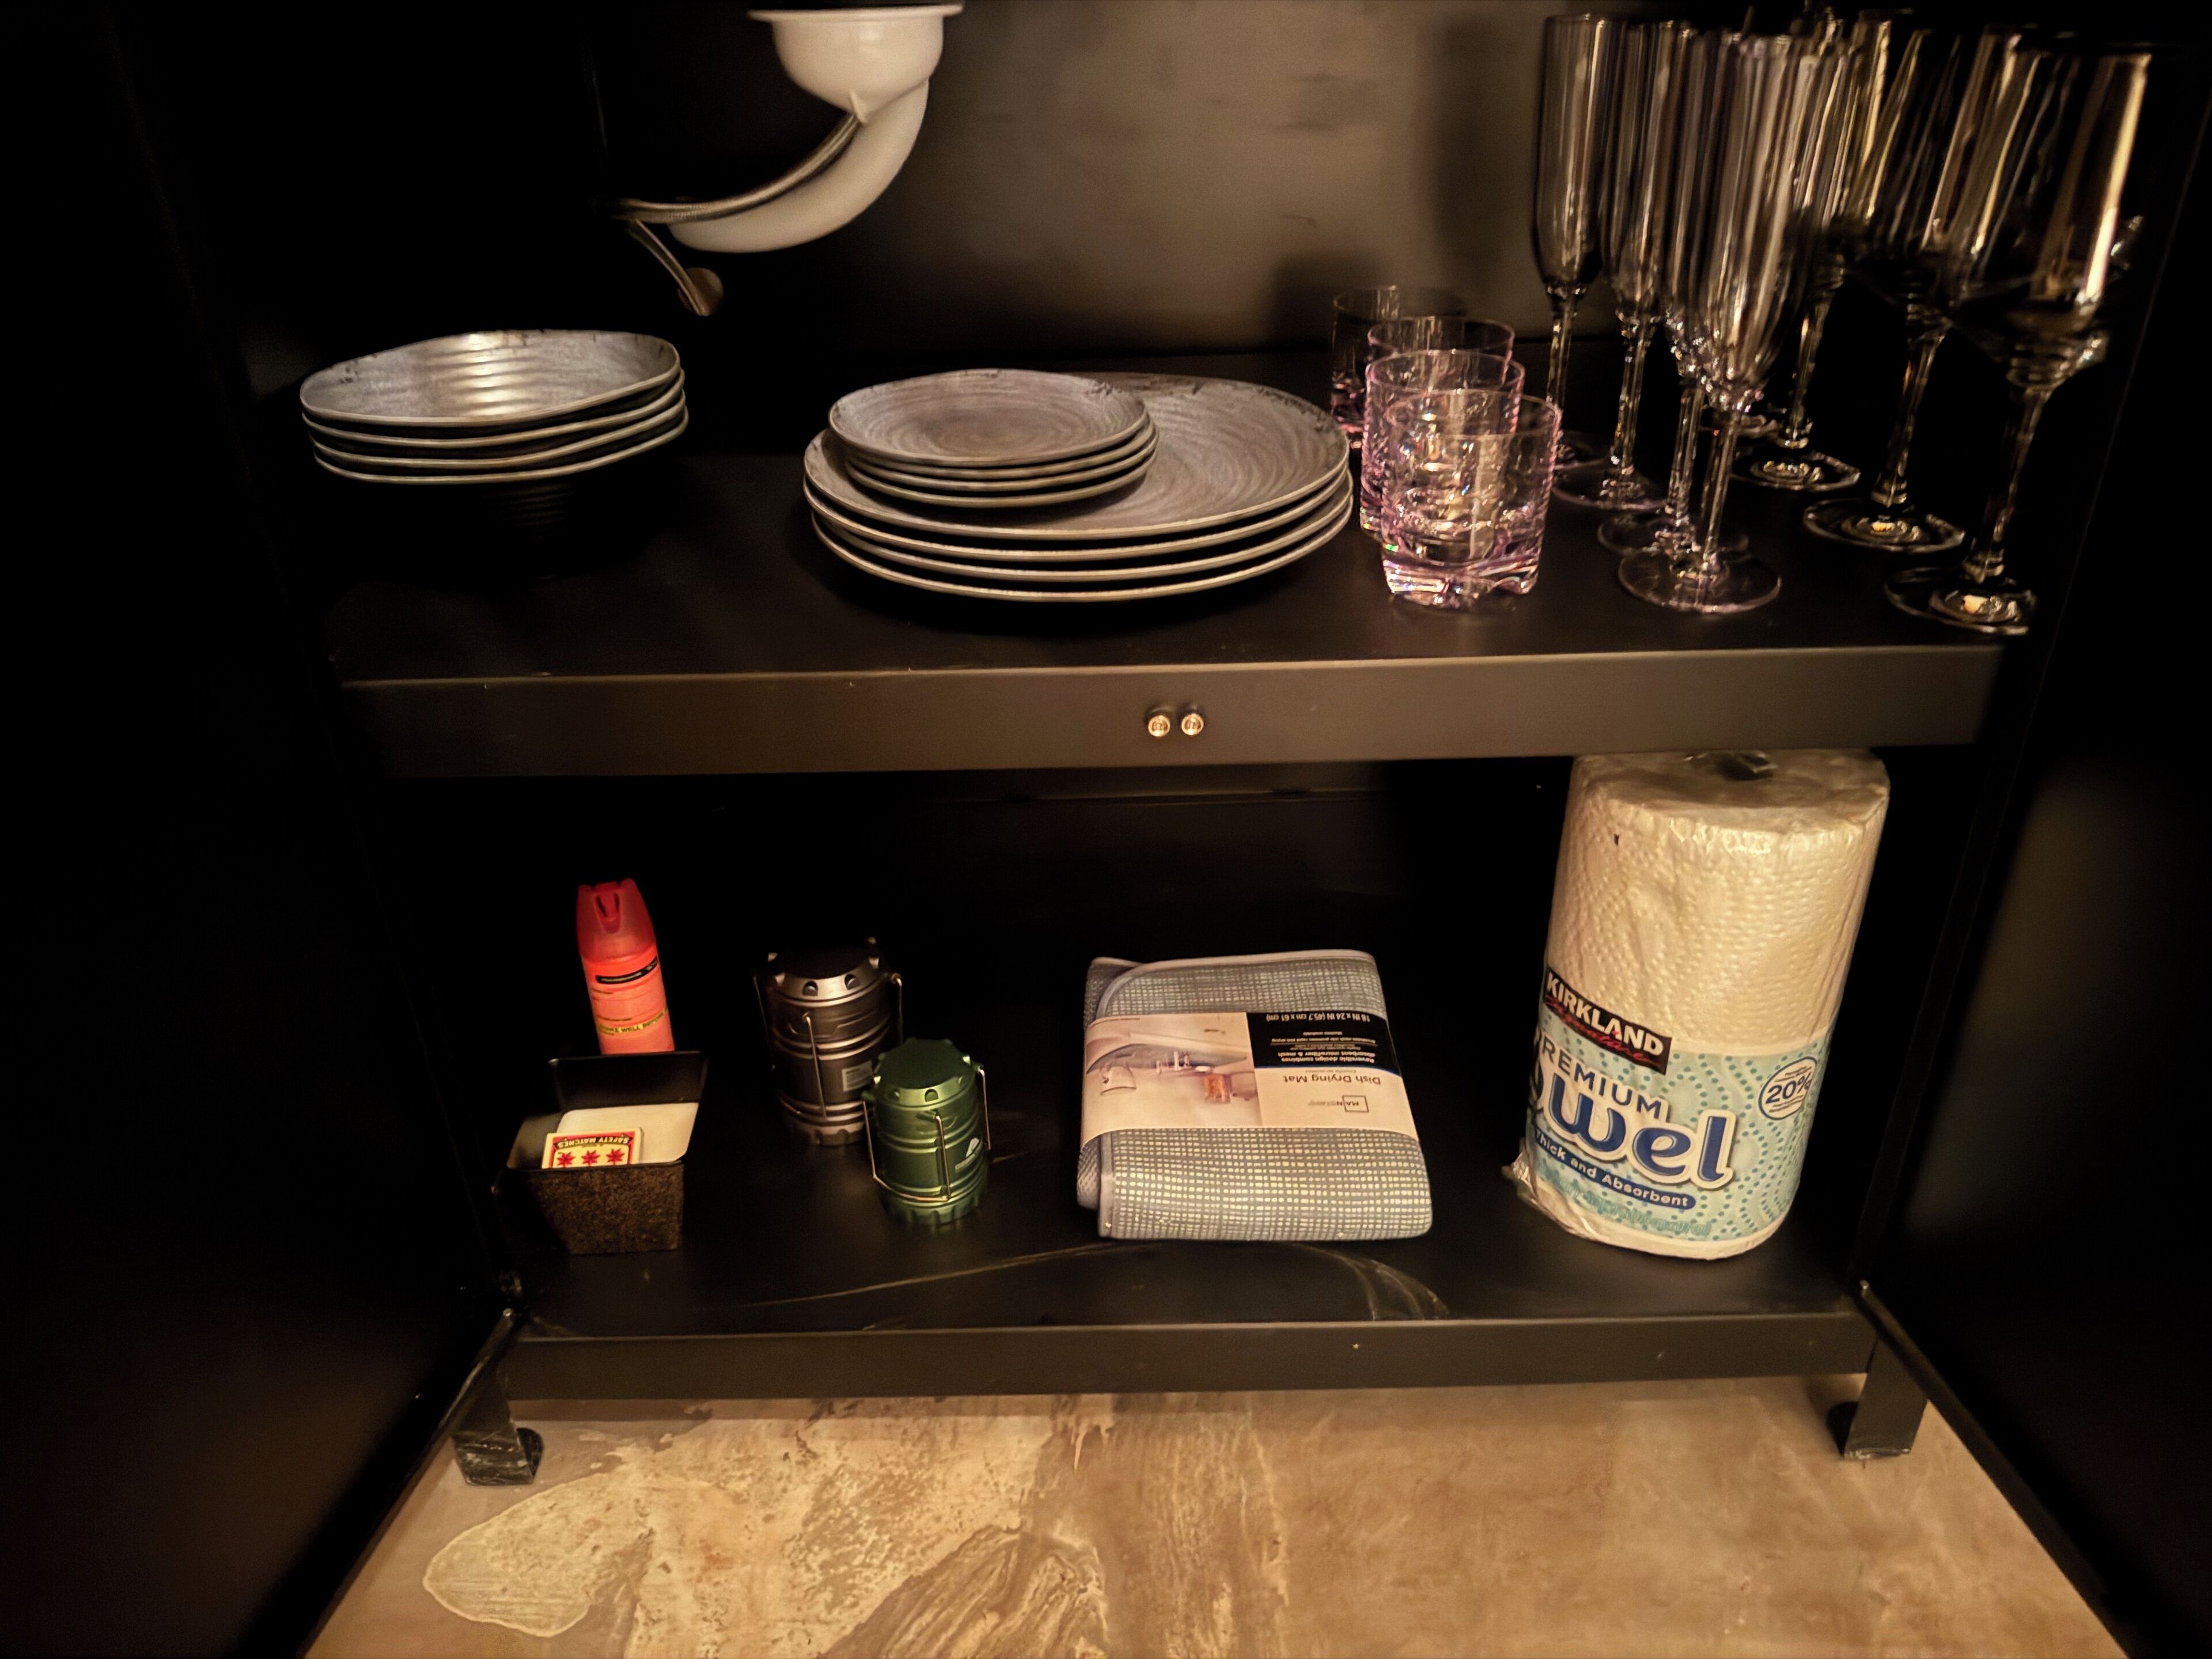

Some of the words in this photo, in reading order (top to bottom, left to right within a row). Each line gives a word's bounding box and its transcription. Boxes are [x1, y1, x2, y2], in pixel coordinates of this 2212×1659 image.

[1266, 1014, 1279, 1022] cm)
[1281, 1014, 1290, 1022] 61
[1336, 1013, 1346, 1021] 24
[1352, 1013, 1361, 1021] IN
[1361, 1014, 1370, 1022] 18
[1547, 972, 1664, 1055] KIRKLAND
[1284, 1075, 1307, 1083] Mat
[1311, 1074, 1351, 1083] Drying
[1539, 1030, 1661, 1119] REMIUM
[1355, 1075, 1381, 1085] Dish
[1765, 1071, 1812, 1104] 20%
[1537, 1066, 1725, 1181] wel
[558, 1137, 596, 1149] MATCHES
[598, 1136, 630, 1144] SAFETY
[1535, 1129, 1565, 1160] Thick
[1570, 1157, 1597, 1178] and
[1601, 1173, 1688, 1207] Absorbent
